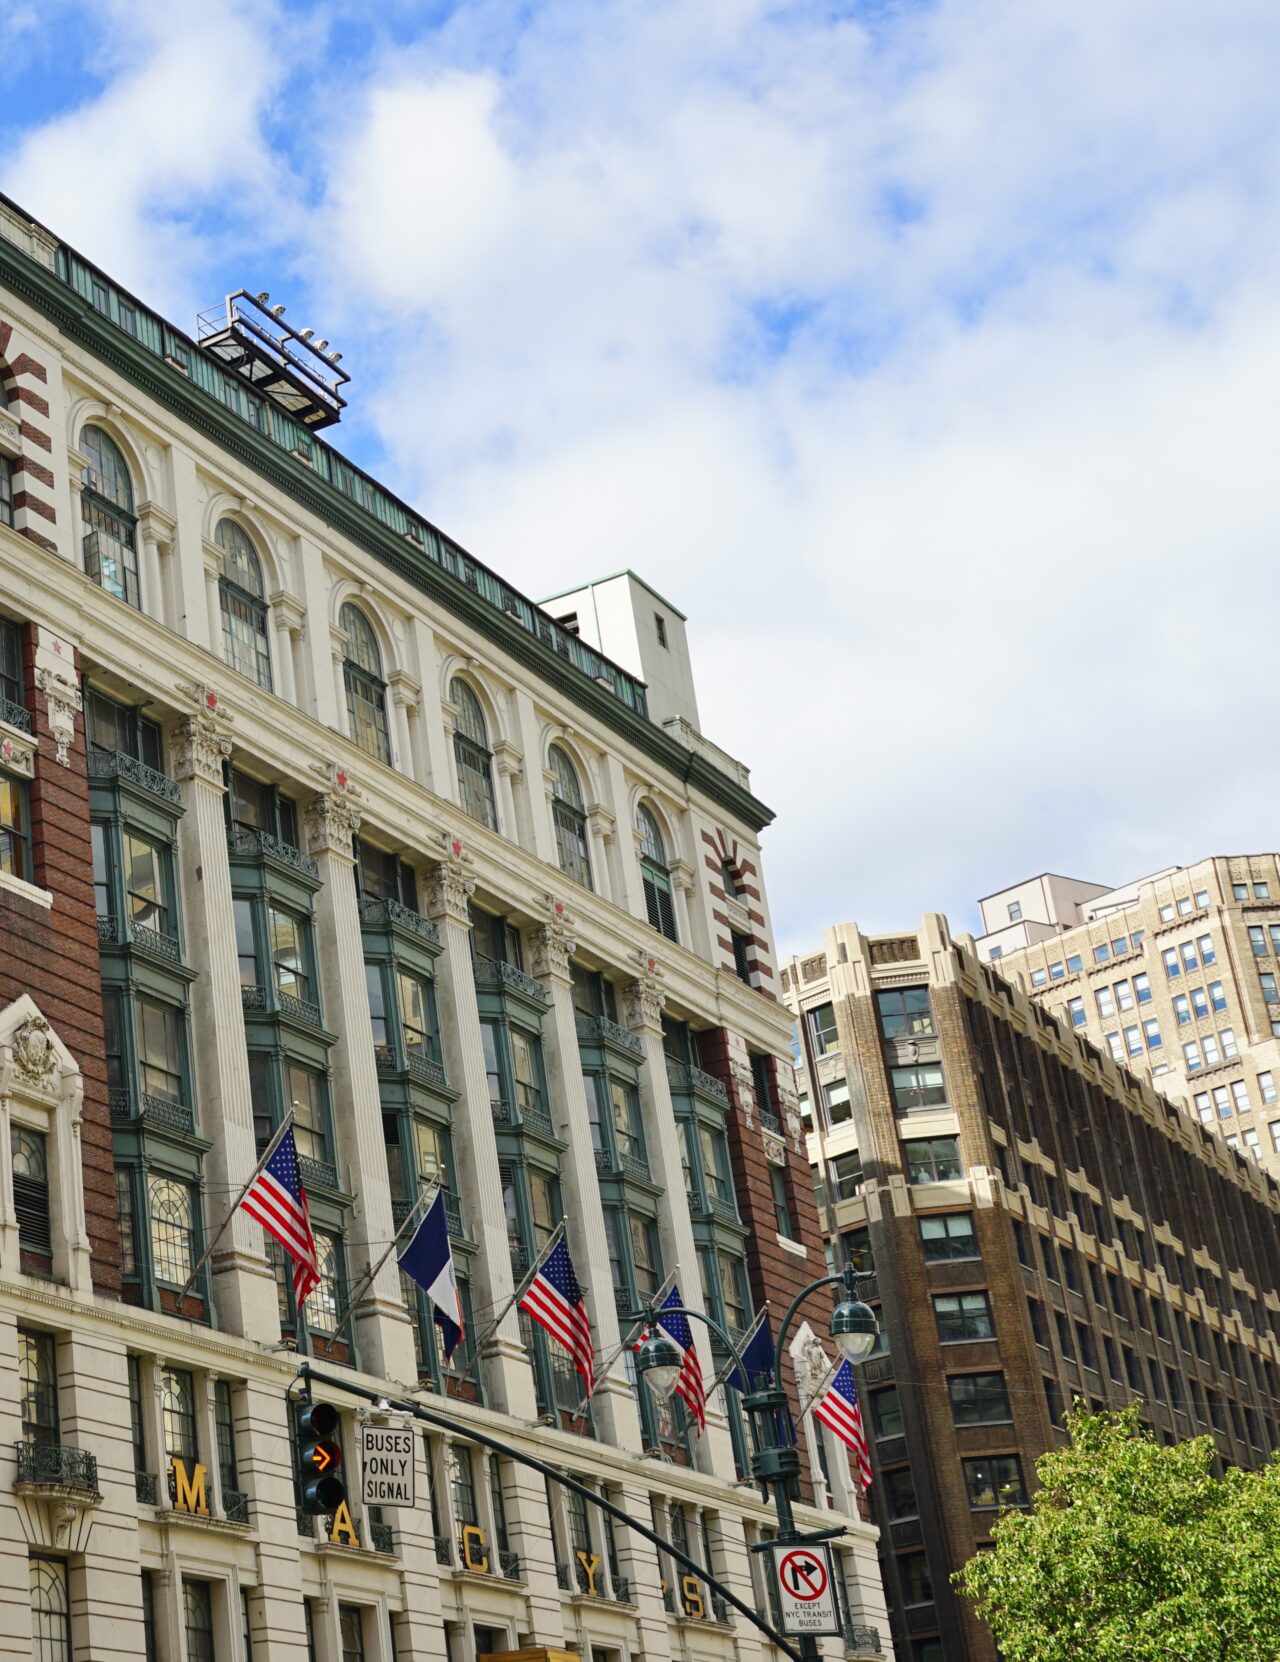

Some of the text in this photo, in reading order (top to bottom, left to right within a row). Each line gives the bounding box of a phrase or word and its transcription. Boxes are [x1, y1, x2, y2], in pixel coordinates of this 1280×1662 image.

[366, 1433, 411, 1454] BUSES
[369, 1457, 407, 1477] ONLY
[367, 1480, 410, 1501] SIGNAL
[794, 1602, 821, 1610] EXCEPT
[803, 1610, 832, 1618] TRANSIT
[798, 1619, 823, 1627] BUSES
